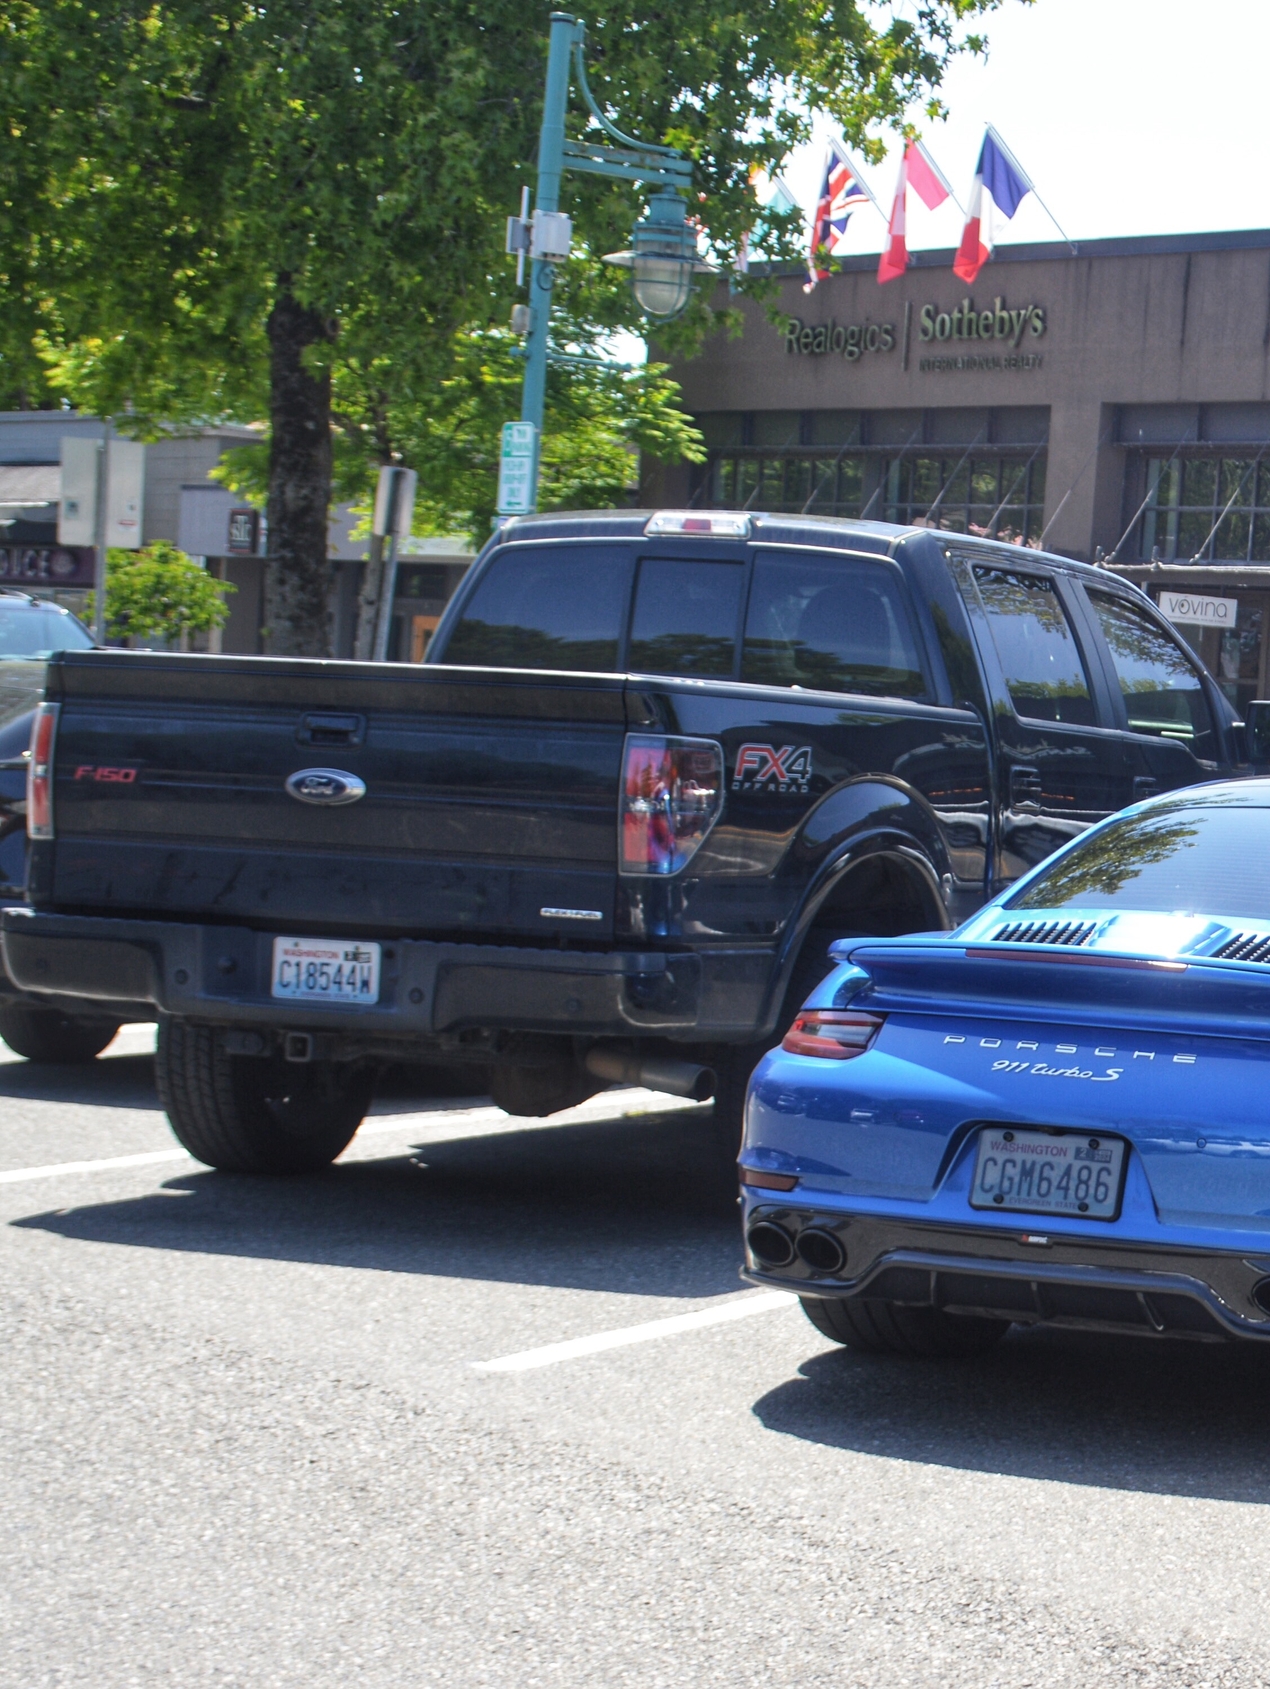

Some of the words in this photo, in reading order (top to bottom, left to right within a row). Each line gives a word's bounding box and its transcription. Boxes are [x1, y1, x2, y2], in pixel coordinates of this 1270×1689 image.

[918, 296, 1046, 348] Sotheby's
[785, 318, 895, 362] Realogics
[73, 765, 138, 783] F-150
[733, 743, 812, 784] FX4
[731, 781, 762, 790] OFF
[767, 783, 809, 793] ROAD
[944, 1035, 1197, 1064] PORSCHE
[991, 1059, 1030, 1073] 911
[1030, 1063, 1093, 1080] turbo
[1090, 1067, 1124, 1081] S
[990, 1140, 1068, 1158] WASHINGTON
[979, 1156, 1112, 1204] CGM6486
[1054, 1200, 1078, 1210] STATE
